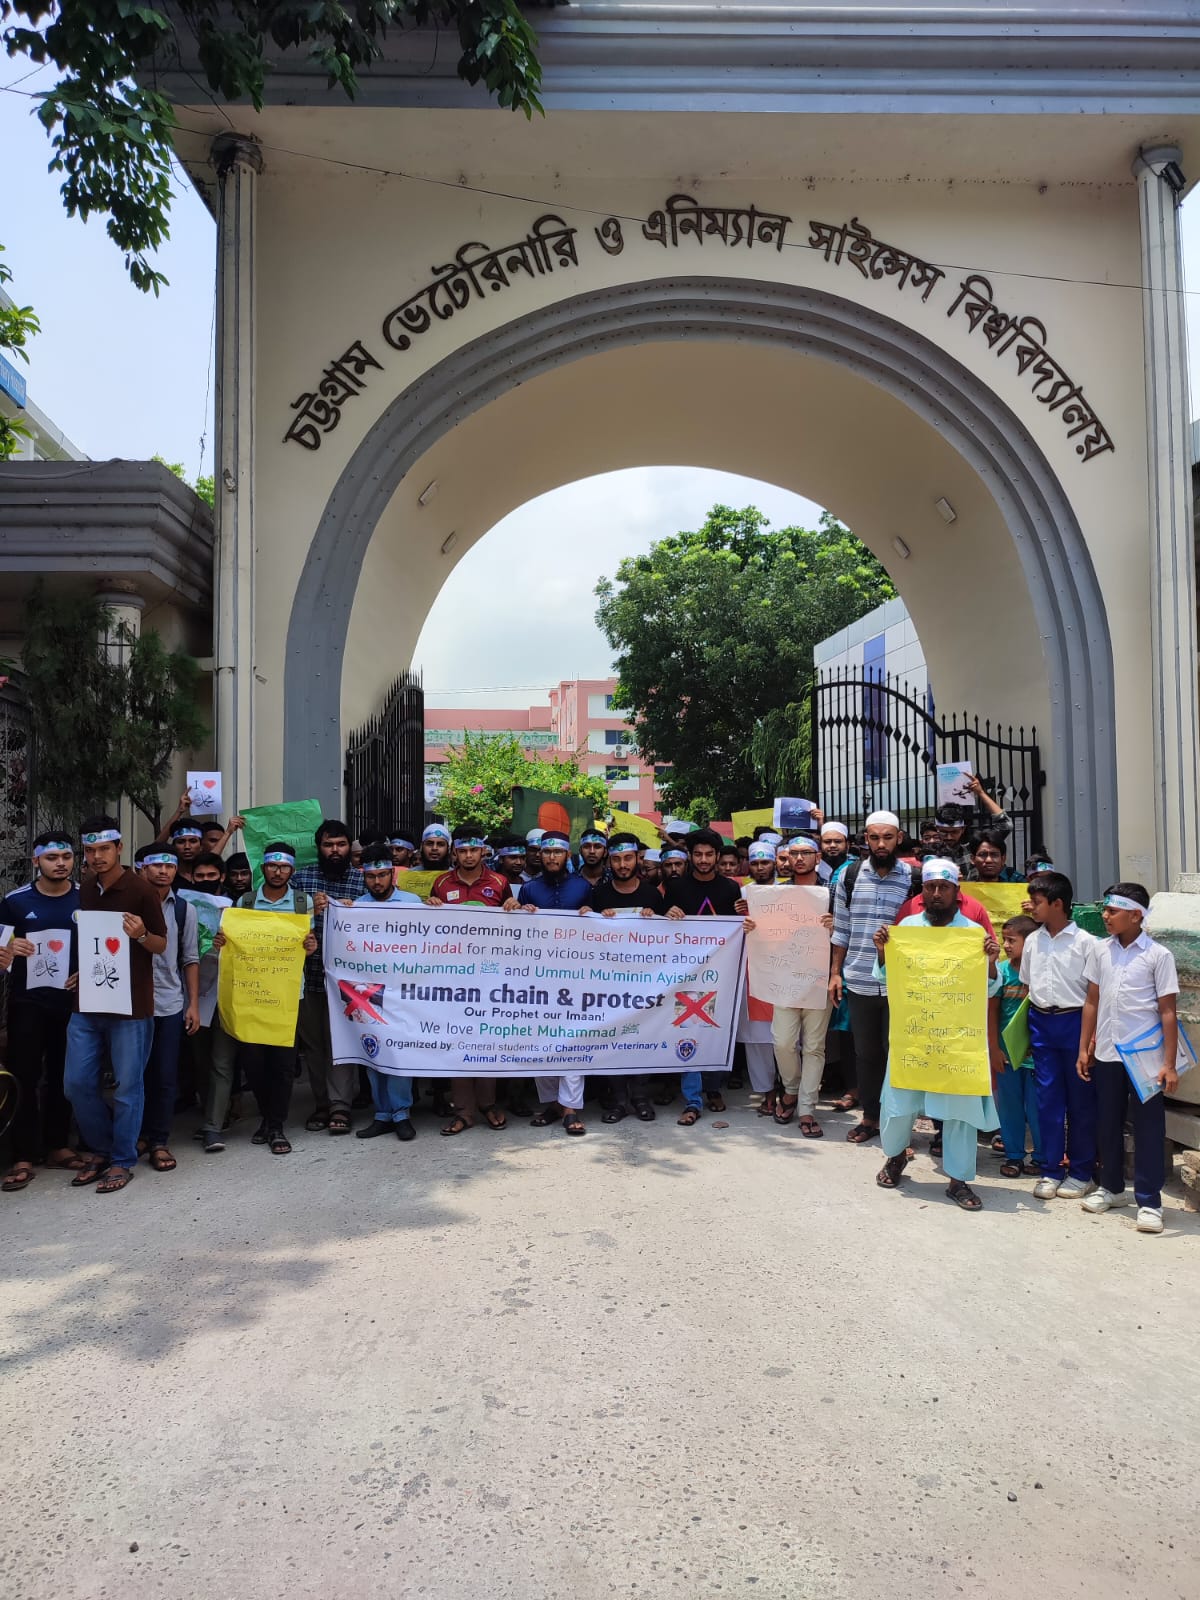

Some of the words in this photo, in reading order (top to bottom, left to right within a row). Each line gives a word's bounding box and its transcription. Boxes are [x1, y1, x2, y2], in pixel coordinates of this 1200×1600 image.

[282, 340, 385, 451] চট্টগ্রাম
[382, 214, 579, 351] ভেটেরিনারি
[594, 217, 624, 256] ও
[642, 194, 793, 252] এনিম্যাল
[946, 274, 1115, 463] বিশ্ববিদ্যালয়
[332, 919, 352, 933] We
[357, 923, 380, 933] are
[385, 921, 431, 937] highly
[434, 924, 522, 940] condemning
[526, 927, 549, 939] the
[553, 928, 577, 940] BJP
[582, 930, 624, 943] leader
[628, 932, 670, 947] Nupur
[674, 933, 726, 946] Sharma
[36, 942, 43, 956] I
[93, 937, 101, 955] I
[345, 940, 357, 952] &
[362, 941, 417, 953] Naveen
[420, 941, 463, 954] Jindal
[466, 943, 487, 955] for
[491, 944, 542, 960] making
[548, 948, 595, 960] vicious
[599, 951, 668, 963] statement
[671, 952, 711, 964] about
[334, 958, 388, 974] Prophet
[393, 962, 475, 975] Muhammad
[504, 965, 530, 977] and
[535, 966, 585, 980] Ummul
[590, 968, 652, 983] Mu'minin
[656, 971, 698, 986] Ayisha
[702, 970, 719, 983] (R)
[400, 983, 482, 1003] Human
[489, 983, 549, 1005] chain
[556, 988, 574, 1006] &
[581, 991, 665, 1012] protest
[464, 1006, 487, 1018] Our
[491, 1008, 539, 1020] Prophet
[543, 1011, 563, 1020] our
[566, 1011, 605, 1021] Imaan!
[420, 1021, 440, 1034] We
[446, 1021, 473, 1034] love
[479, 1023, 532, 1038] Prophet
[538, 1025, 616, 1038] Muhammad
[385, 1038, 438, 1050] Organized
[440, 1040, 454, 1051] by:
[457, 1041, 495, 1051] General
[498, 1043, 539, 1052] students
[542, 1043, 553, 1052] of
[555, 1043, 609, 1054] Chattogram
[611, 1042, 659, 1052] Veterinary
[661, 1041, 668, 1049] &
[463, 1054, 497, 1063] Animal
[500, 1055, 544, 1064] Sciences
[546, 1055, 594, 1064] University
